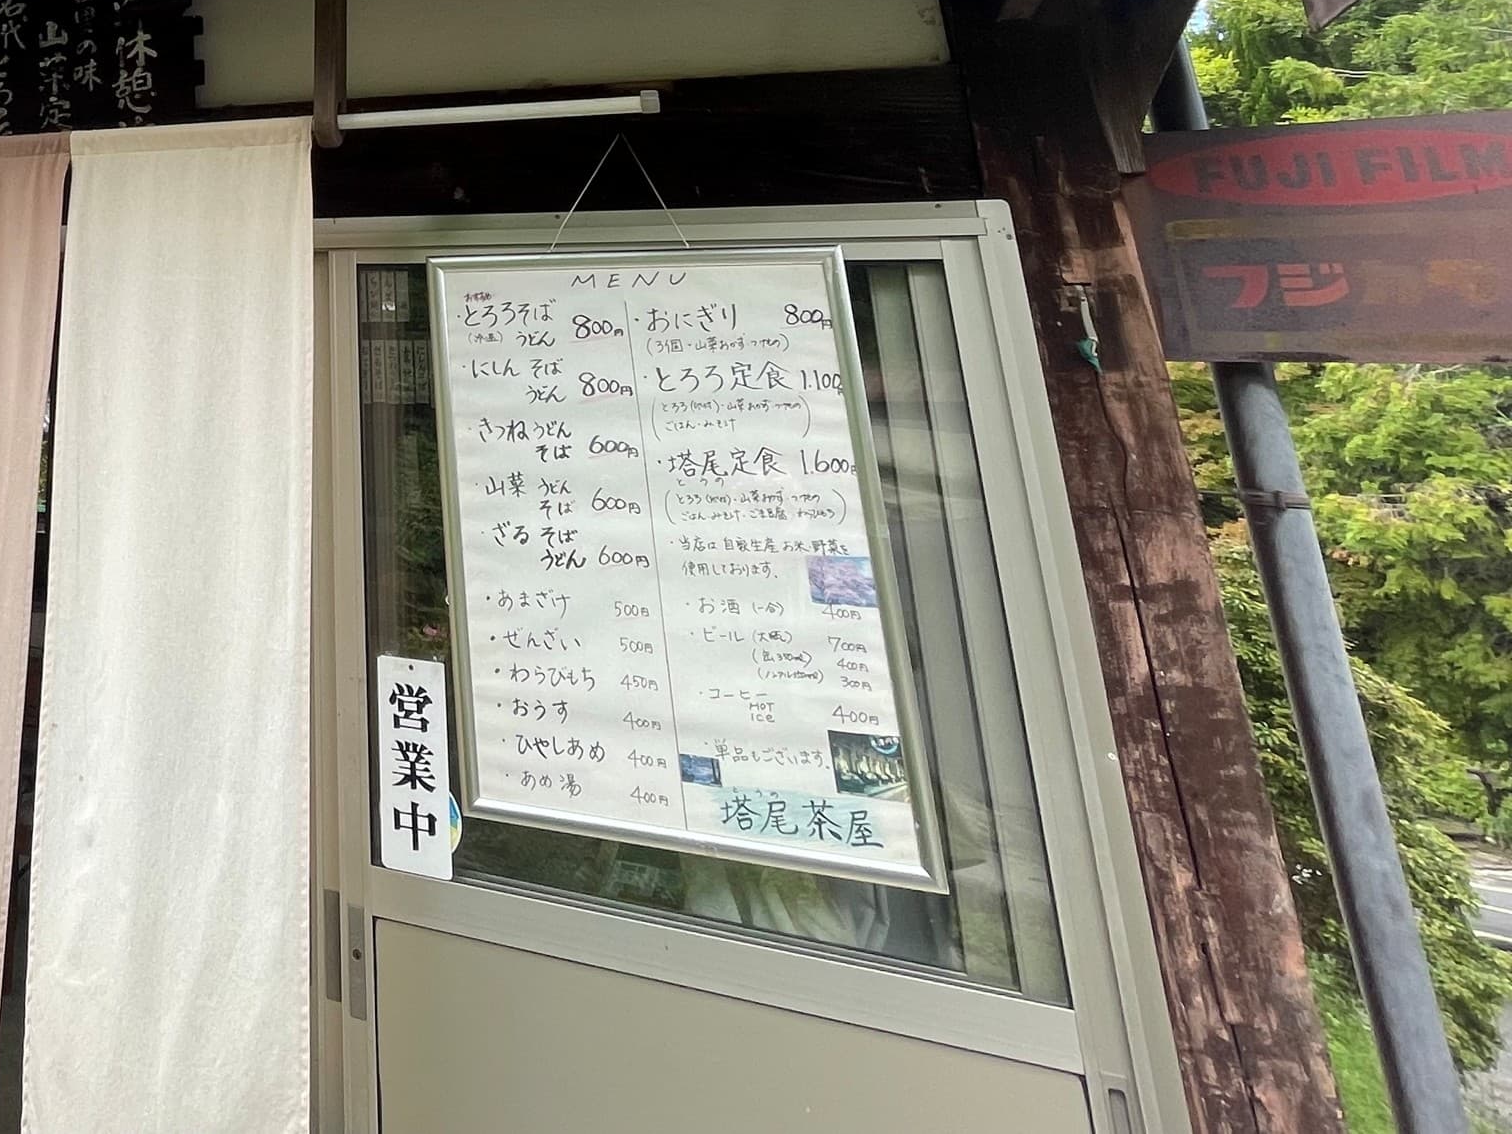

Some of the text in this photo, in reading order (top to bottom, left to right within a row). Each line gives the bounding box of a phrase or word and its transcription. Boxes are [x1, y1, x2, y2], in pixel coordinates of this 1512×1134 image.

[1192, 140, 1512, 193] FUJI FILM
[571, 273, 687, 289] MENU
[464, 299, 624, 339] とろろそば 800円
[647, 303, 833, 333] おにぎり 800円
[516, 331, 556, 347] うどん
[526, 372, 634, 404] うどん 800円
[655, 361, 793, 393] とろろ定食
[535, 435, 639, 463] そば 600円
[668, 446, 787, 478] 塔尾定食
[539, 487, 641, 520] そば 600円
[540, 545, 649, 570] うどん 600円
[498, 589, 650, 619] あまざけ 500円
[822, 603, 861, 620] 400円
[503, 627, 654, 654] ぜんざい 500円
[828, 636, 867, 653] 700円
[510, 663, 659, 691] わらびもち 450円
[512, 698, 661, 731] おうす 400円
[832, 705, 879, 725] 400円
[389, 681, 437, 852] 営業中
[516, 734, 667, 769] ひやしあめ 400円
[630, 785, 669, 806] 400円
[720, 793, 884, 848] 塔尾茶屋
